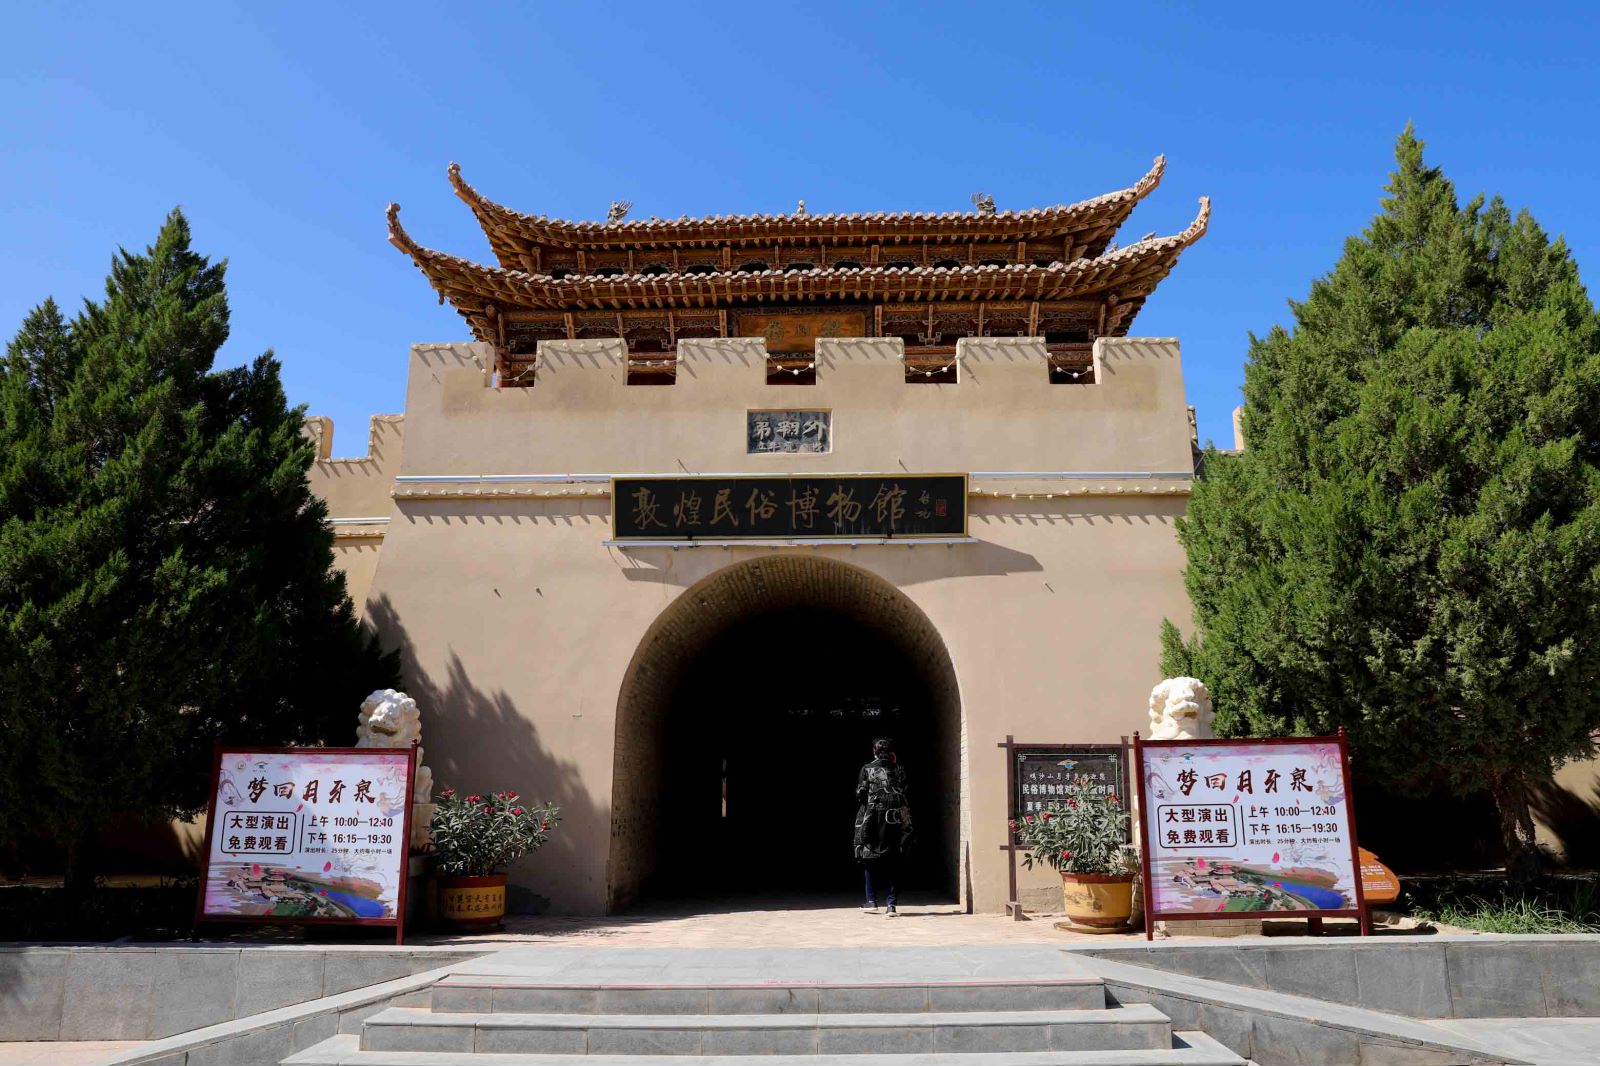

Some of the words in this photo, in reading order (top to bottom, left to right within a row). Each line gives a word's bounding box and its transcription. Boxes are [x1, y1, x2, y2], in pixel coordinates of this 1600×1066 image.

[246, 775, 376, 804] 梦回月牙泉
[1177, 767, 1314, 796] 梦回月牙泉
[1164, 807, 1228, 823] 大型演出
[1248, 805, 1270, 818] 上午
[230, 815, 289, 831] 大型演出
[308, 815, 329, 828] 上午
[1249, 823, 1271, 836] 下午
[228, 835, 288, 851] 免费观看
[307, 832, 328, 845] 下午
[1166, 828, 1230, 844] 免费观看
